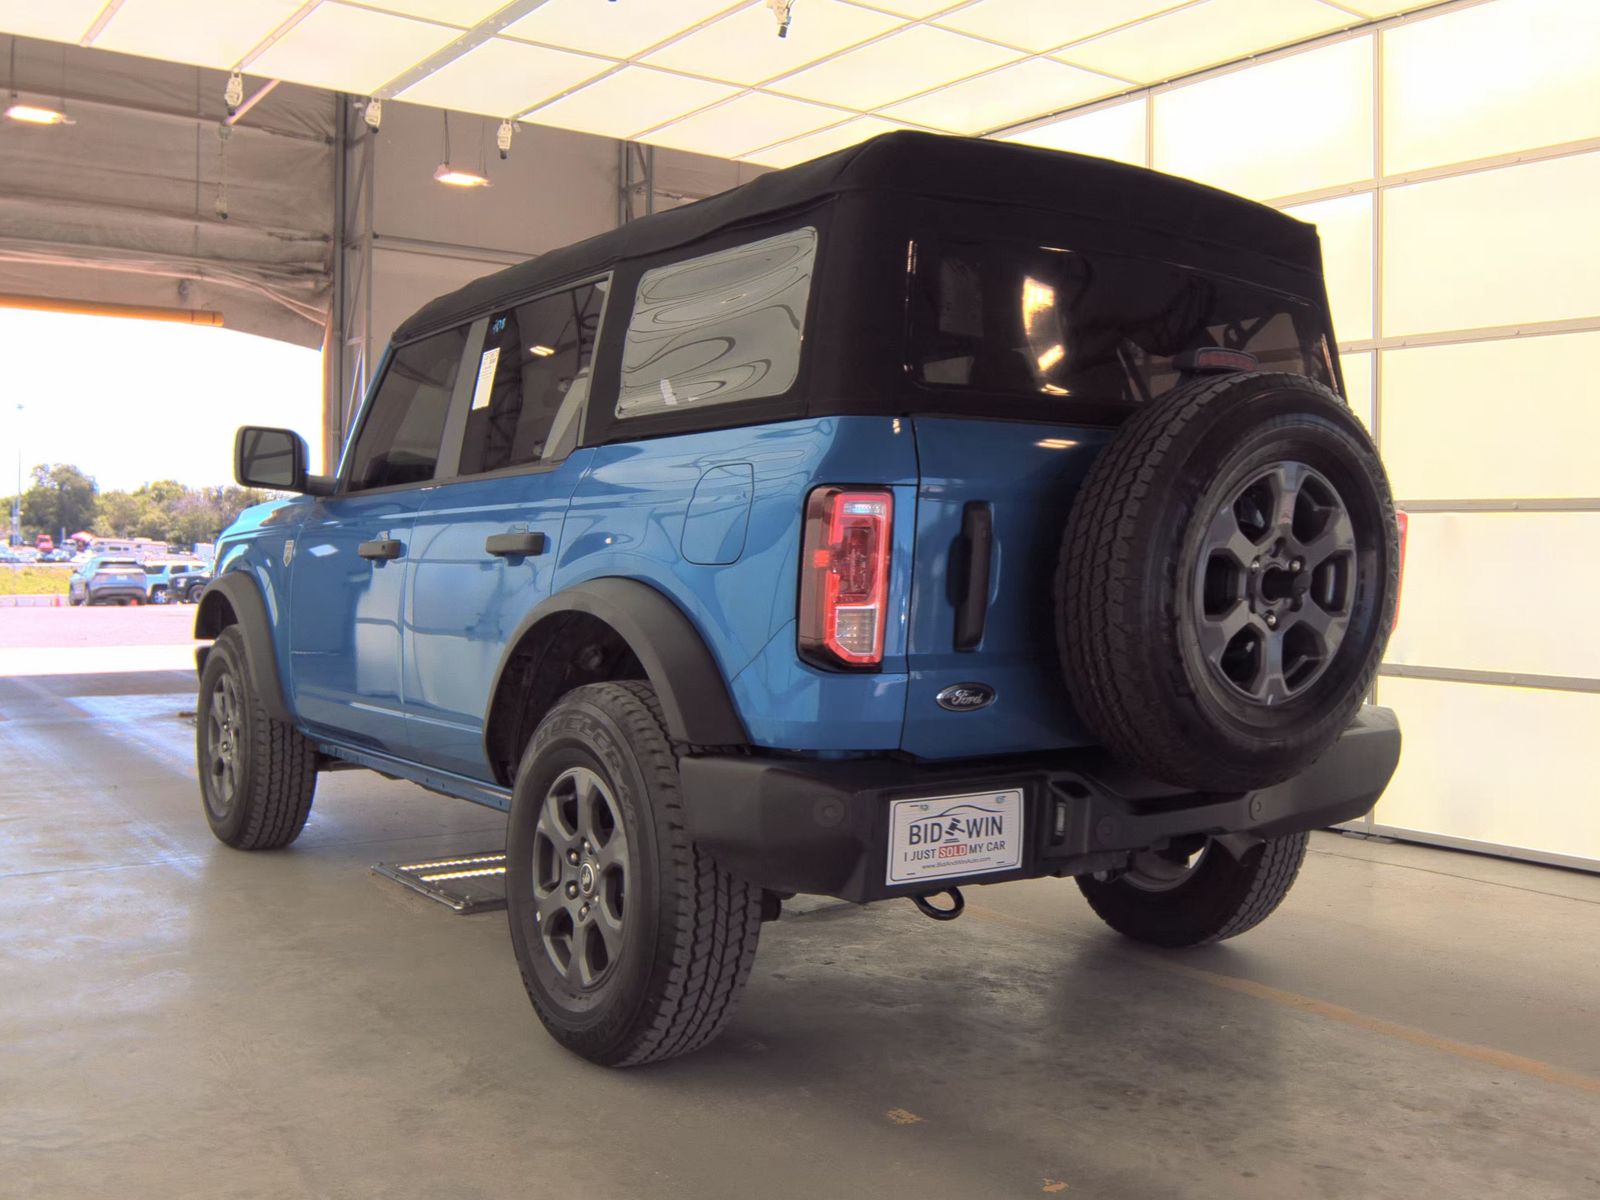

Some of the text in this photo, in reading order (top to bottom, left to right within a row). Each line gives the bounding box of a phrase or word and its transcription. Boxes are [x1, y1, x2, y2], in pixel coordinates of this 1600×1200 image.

[952, 689, 983, 705] Ford
[909, 815, 1003, 845] BID WIN
[910, 849, 937, 861] JUST
[939, 845, 967, 858] SOLD
[969, 844, 983, 854] MY
[987, 840, 1006, 852] CAR
